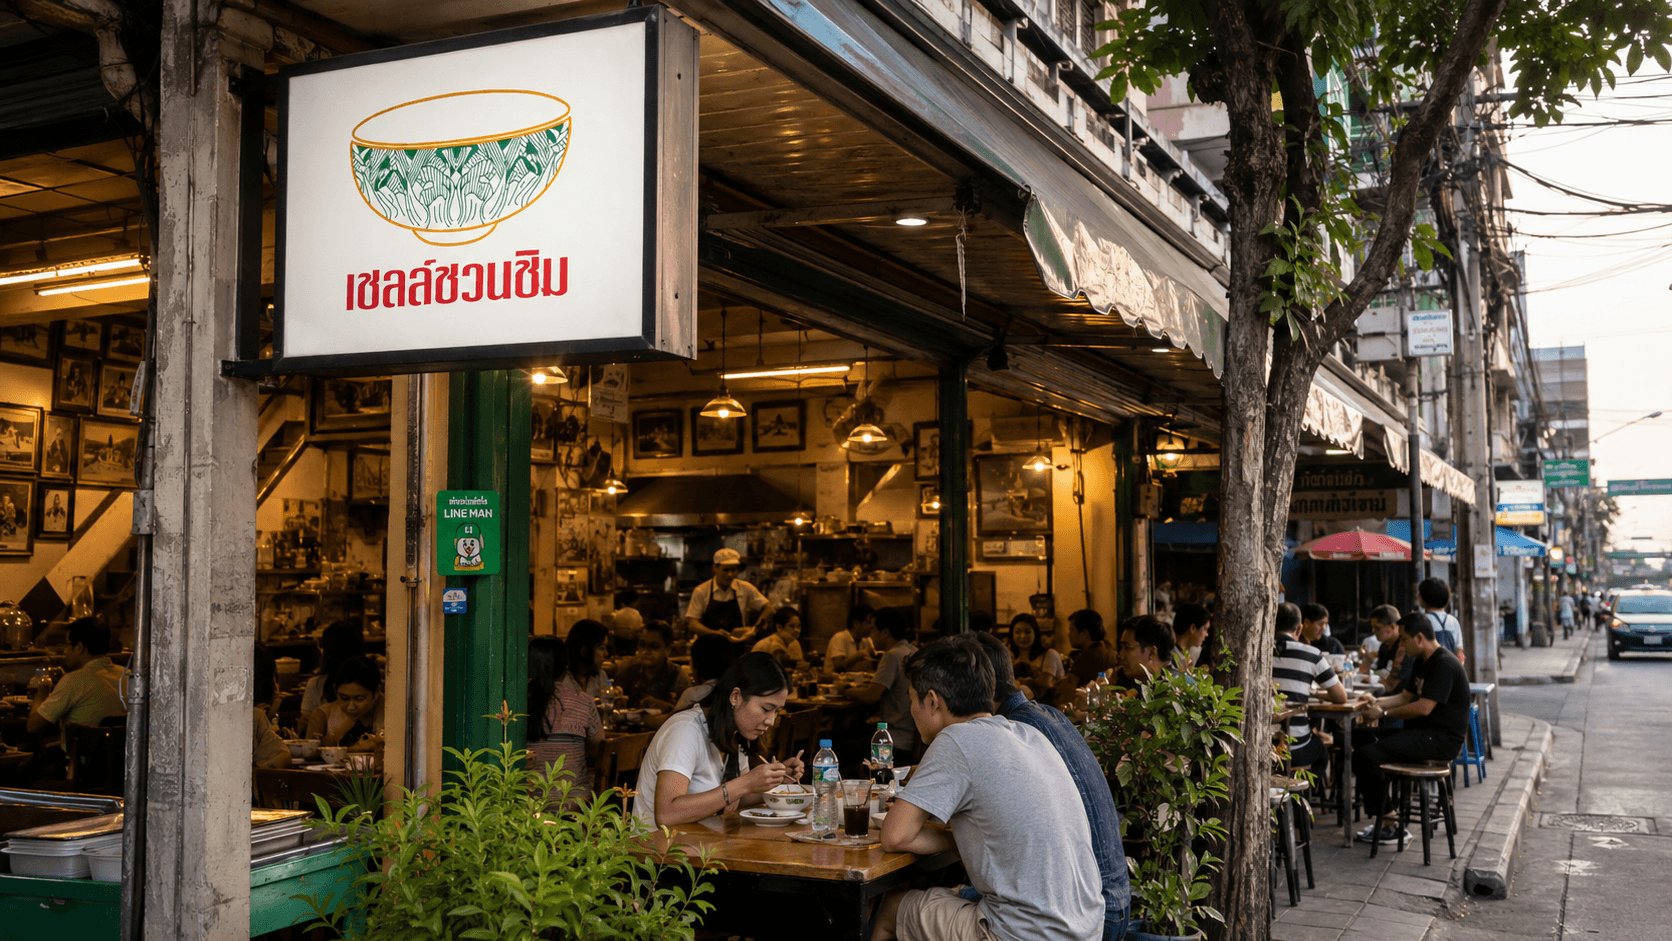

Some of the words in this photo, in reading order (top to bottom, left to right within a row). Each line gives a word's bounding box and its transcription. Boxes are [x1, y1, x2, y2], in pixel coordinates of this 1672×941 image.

[346, 249, 569, 311] เชลล์ชวนชิม
[444, 508, 468, 518] LINE
[469, 508, 493, 518] MAN
